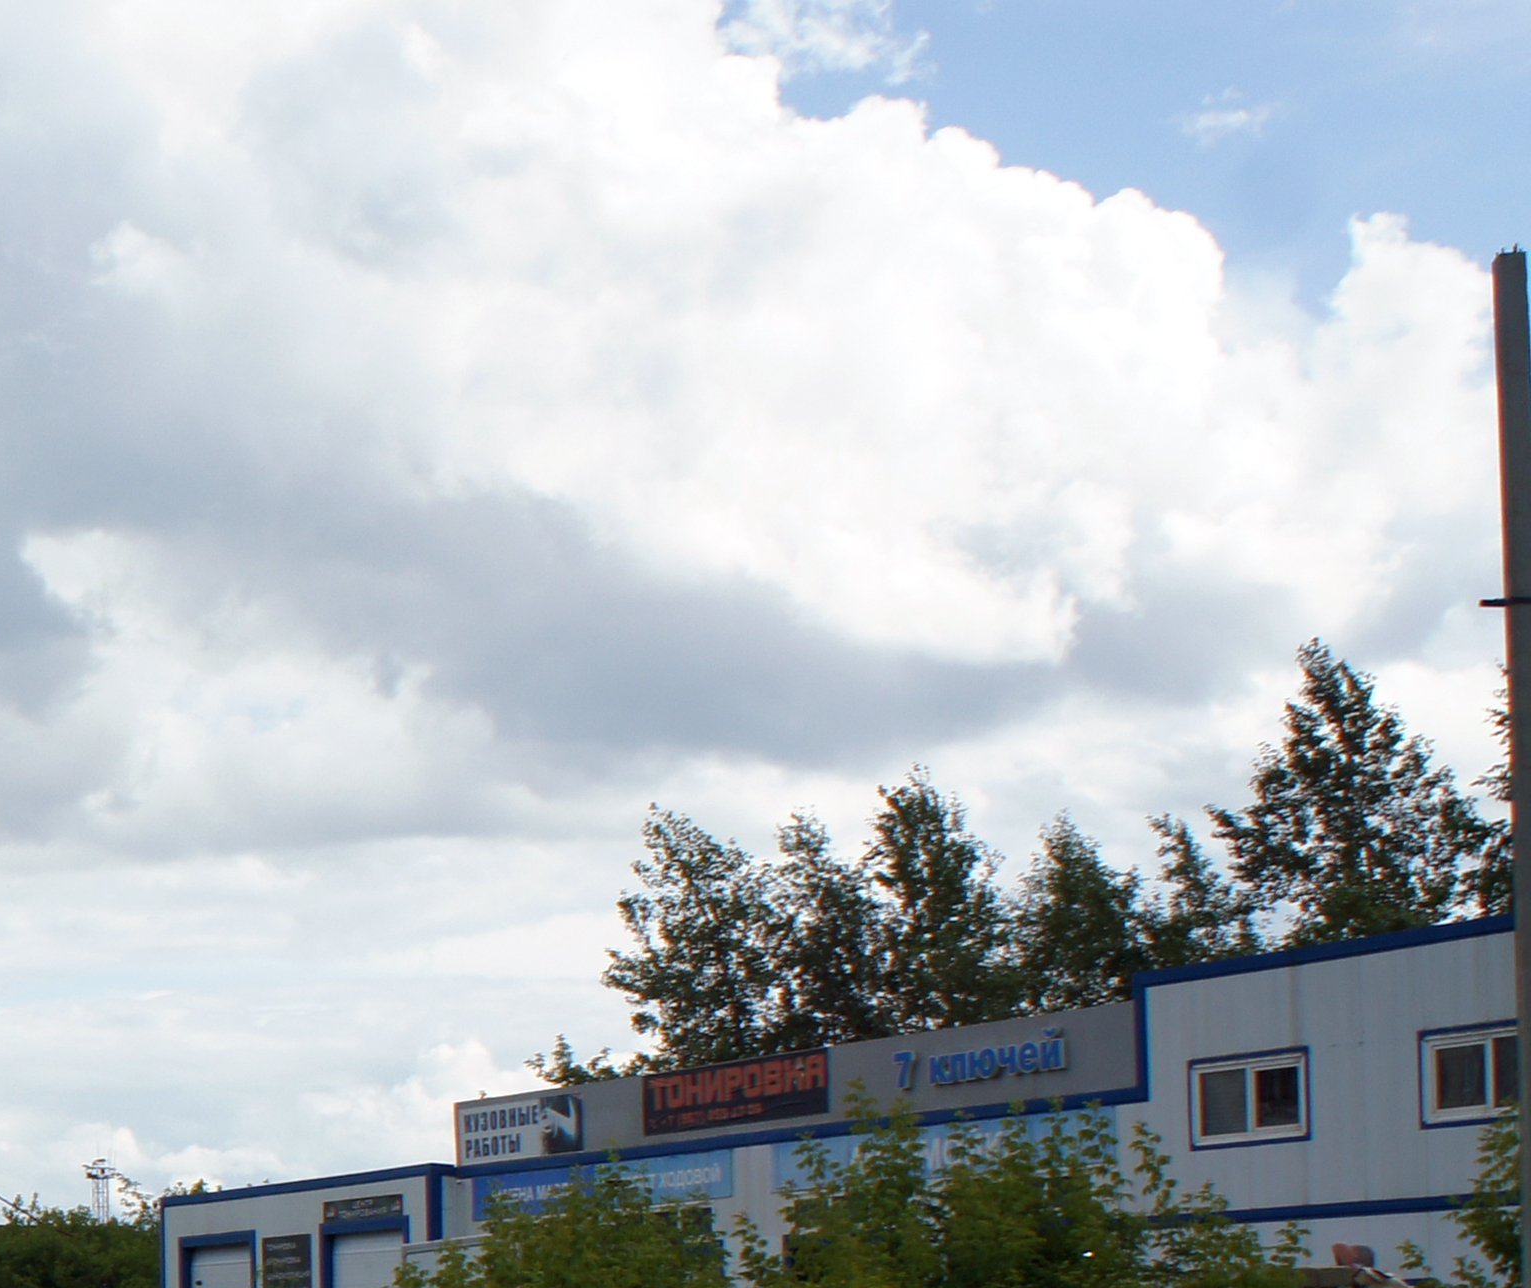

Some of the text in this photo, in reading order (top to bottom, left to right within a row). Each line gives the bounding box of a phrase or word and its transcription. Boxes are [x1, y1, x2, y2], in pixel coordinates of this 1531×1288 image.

[893, 1027, 1067, 1089] 7 ключей
[648, 1053, 827, 1111] ТОНИРОВКА
[464, 1104, 539, 1133] КУЗОВНЫЕ
[465, 1133, 521, 1159] РАБОТЫ
[659, 1162, 722, 1189] ХОДОВОЙ
